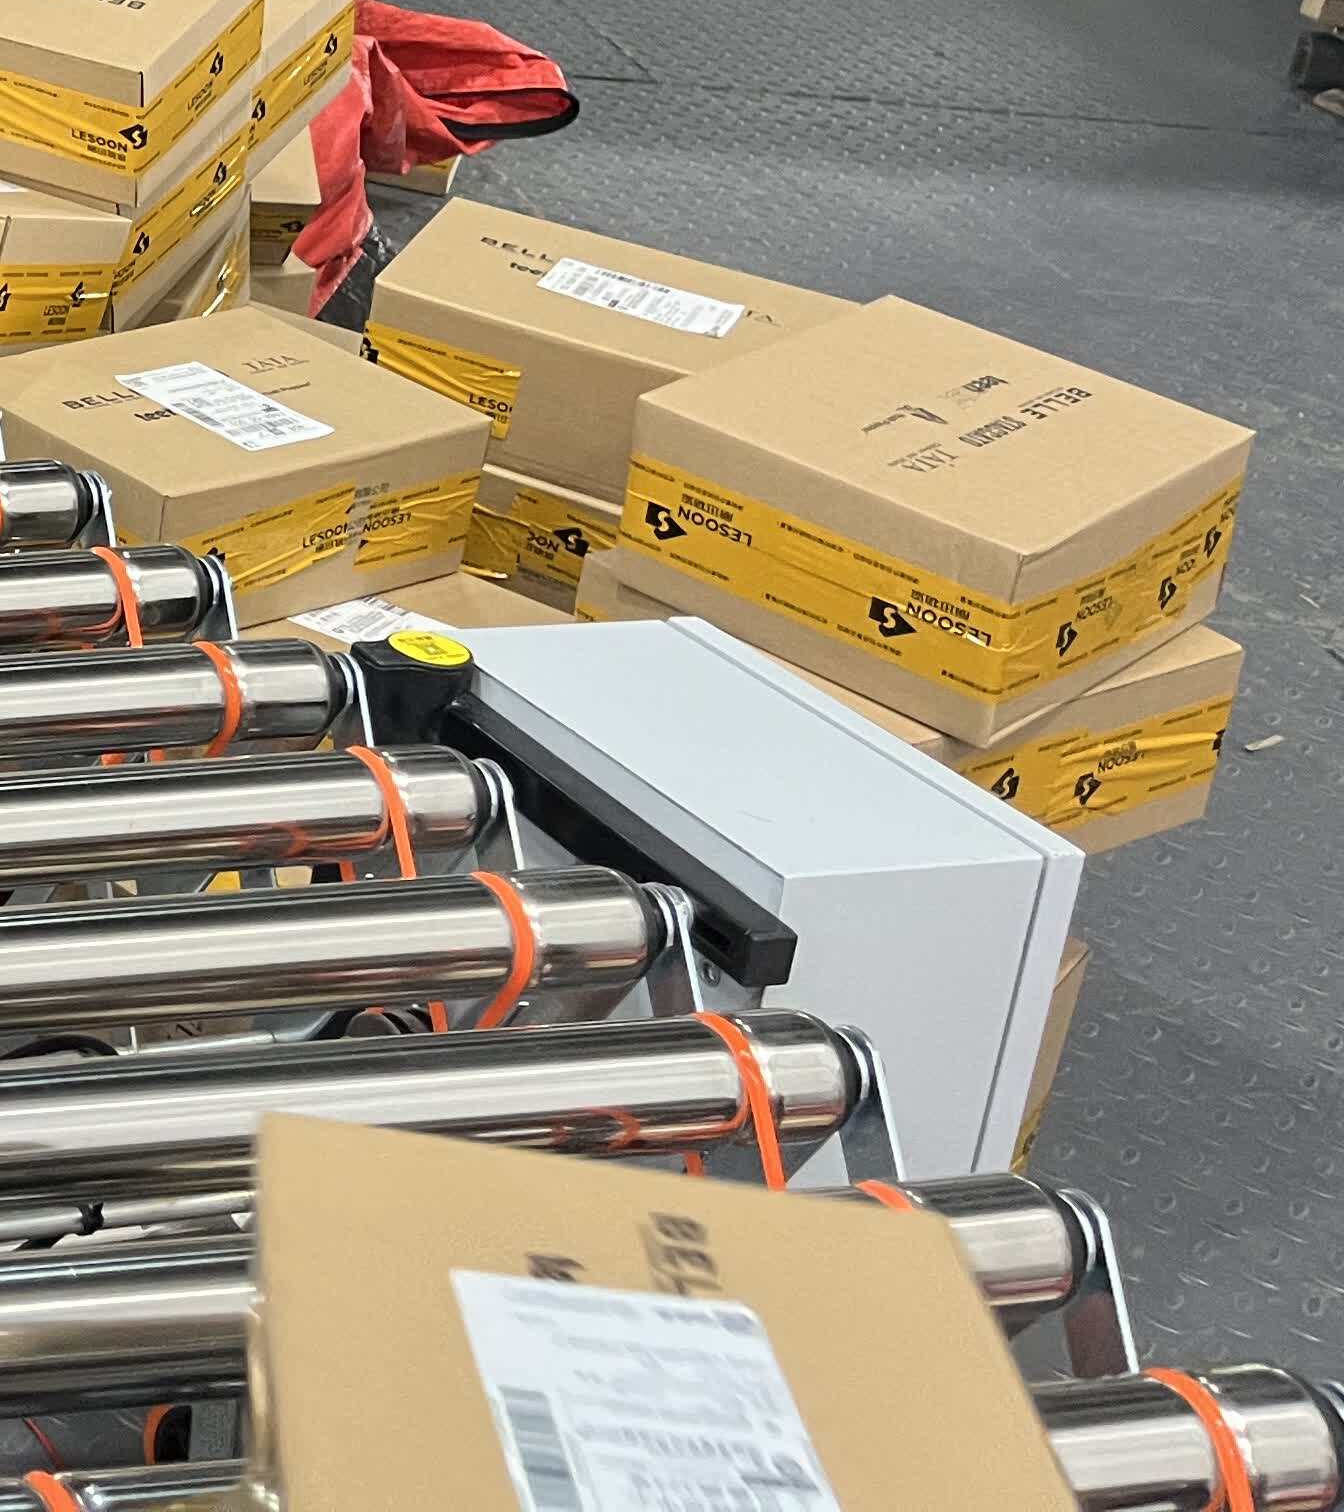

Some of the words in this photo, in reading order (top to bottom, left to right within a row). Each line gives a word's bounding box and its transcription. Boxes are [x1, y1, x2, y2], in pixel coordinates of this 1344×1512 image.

[71, 127, 128, 153] LESOON
[1020, 387, 1093, 420] BELLE
[678, 505, 753, 549] LESOON
[906, 601, 992, 647] LESOON
